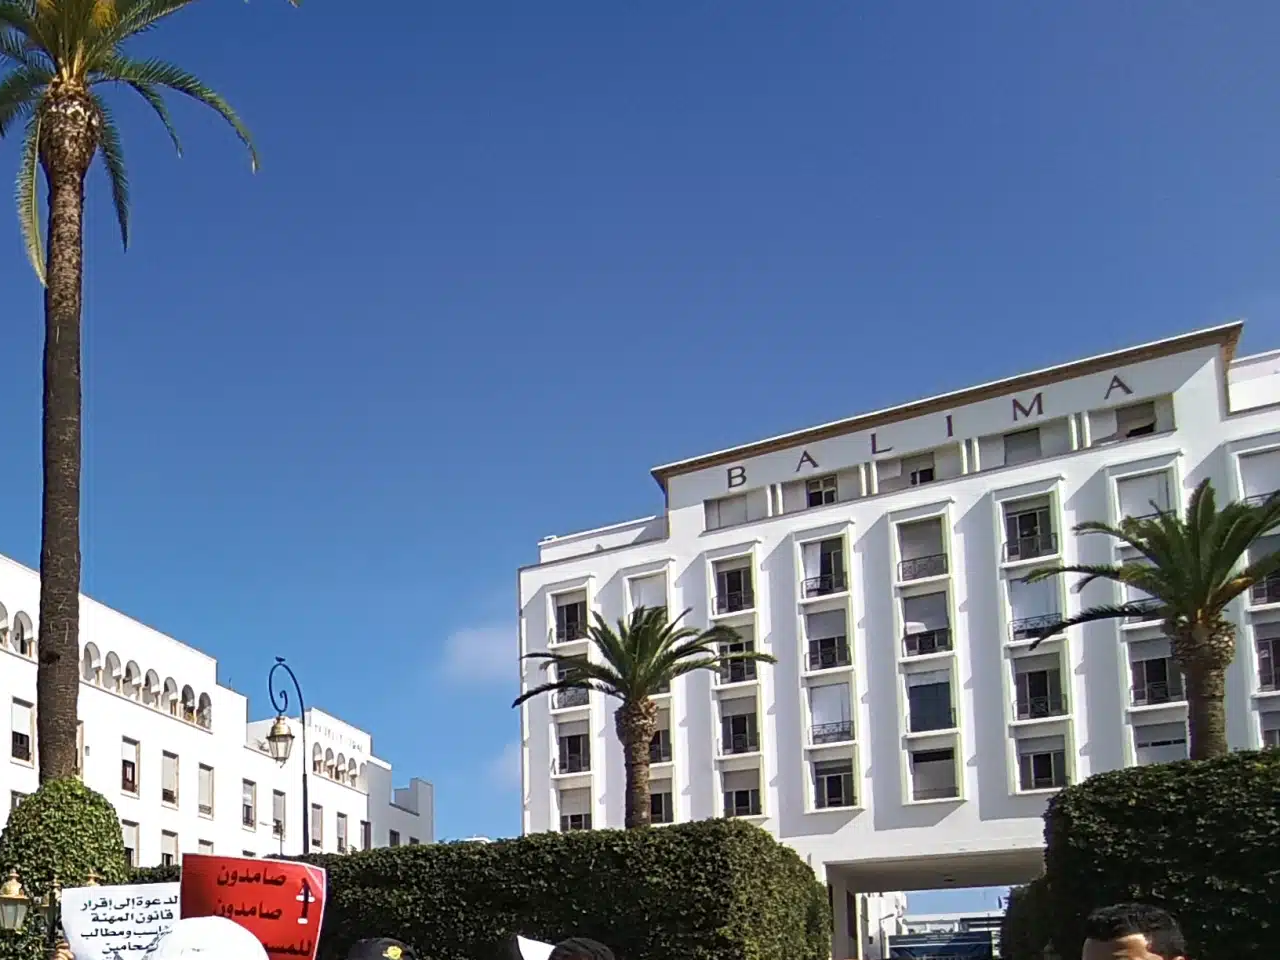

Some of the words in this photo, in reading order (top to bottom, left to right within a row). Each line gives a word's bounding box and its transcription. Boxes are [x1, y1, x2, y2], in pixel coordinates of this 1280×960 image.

[727, 374, 1133, 488] BALIMA
[217, 865, 287, 886] صامدون
[80, 897, 112, 911] إقرار
[114, 897, 135, 910] إلى
[91, 912, 134, 924] المهنة
[135, 909, 174, 924] قانون
